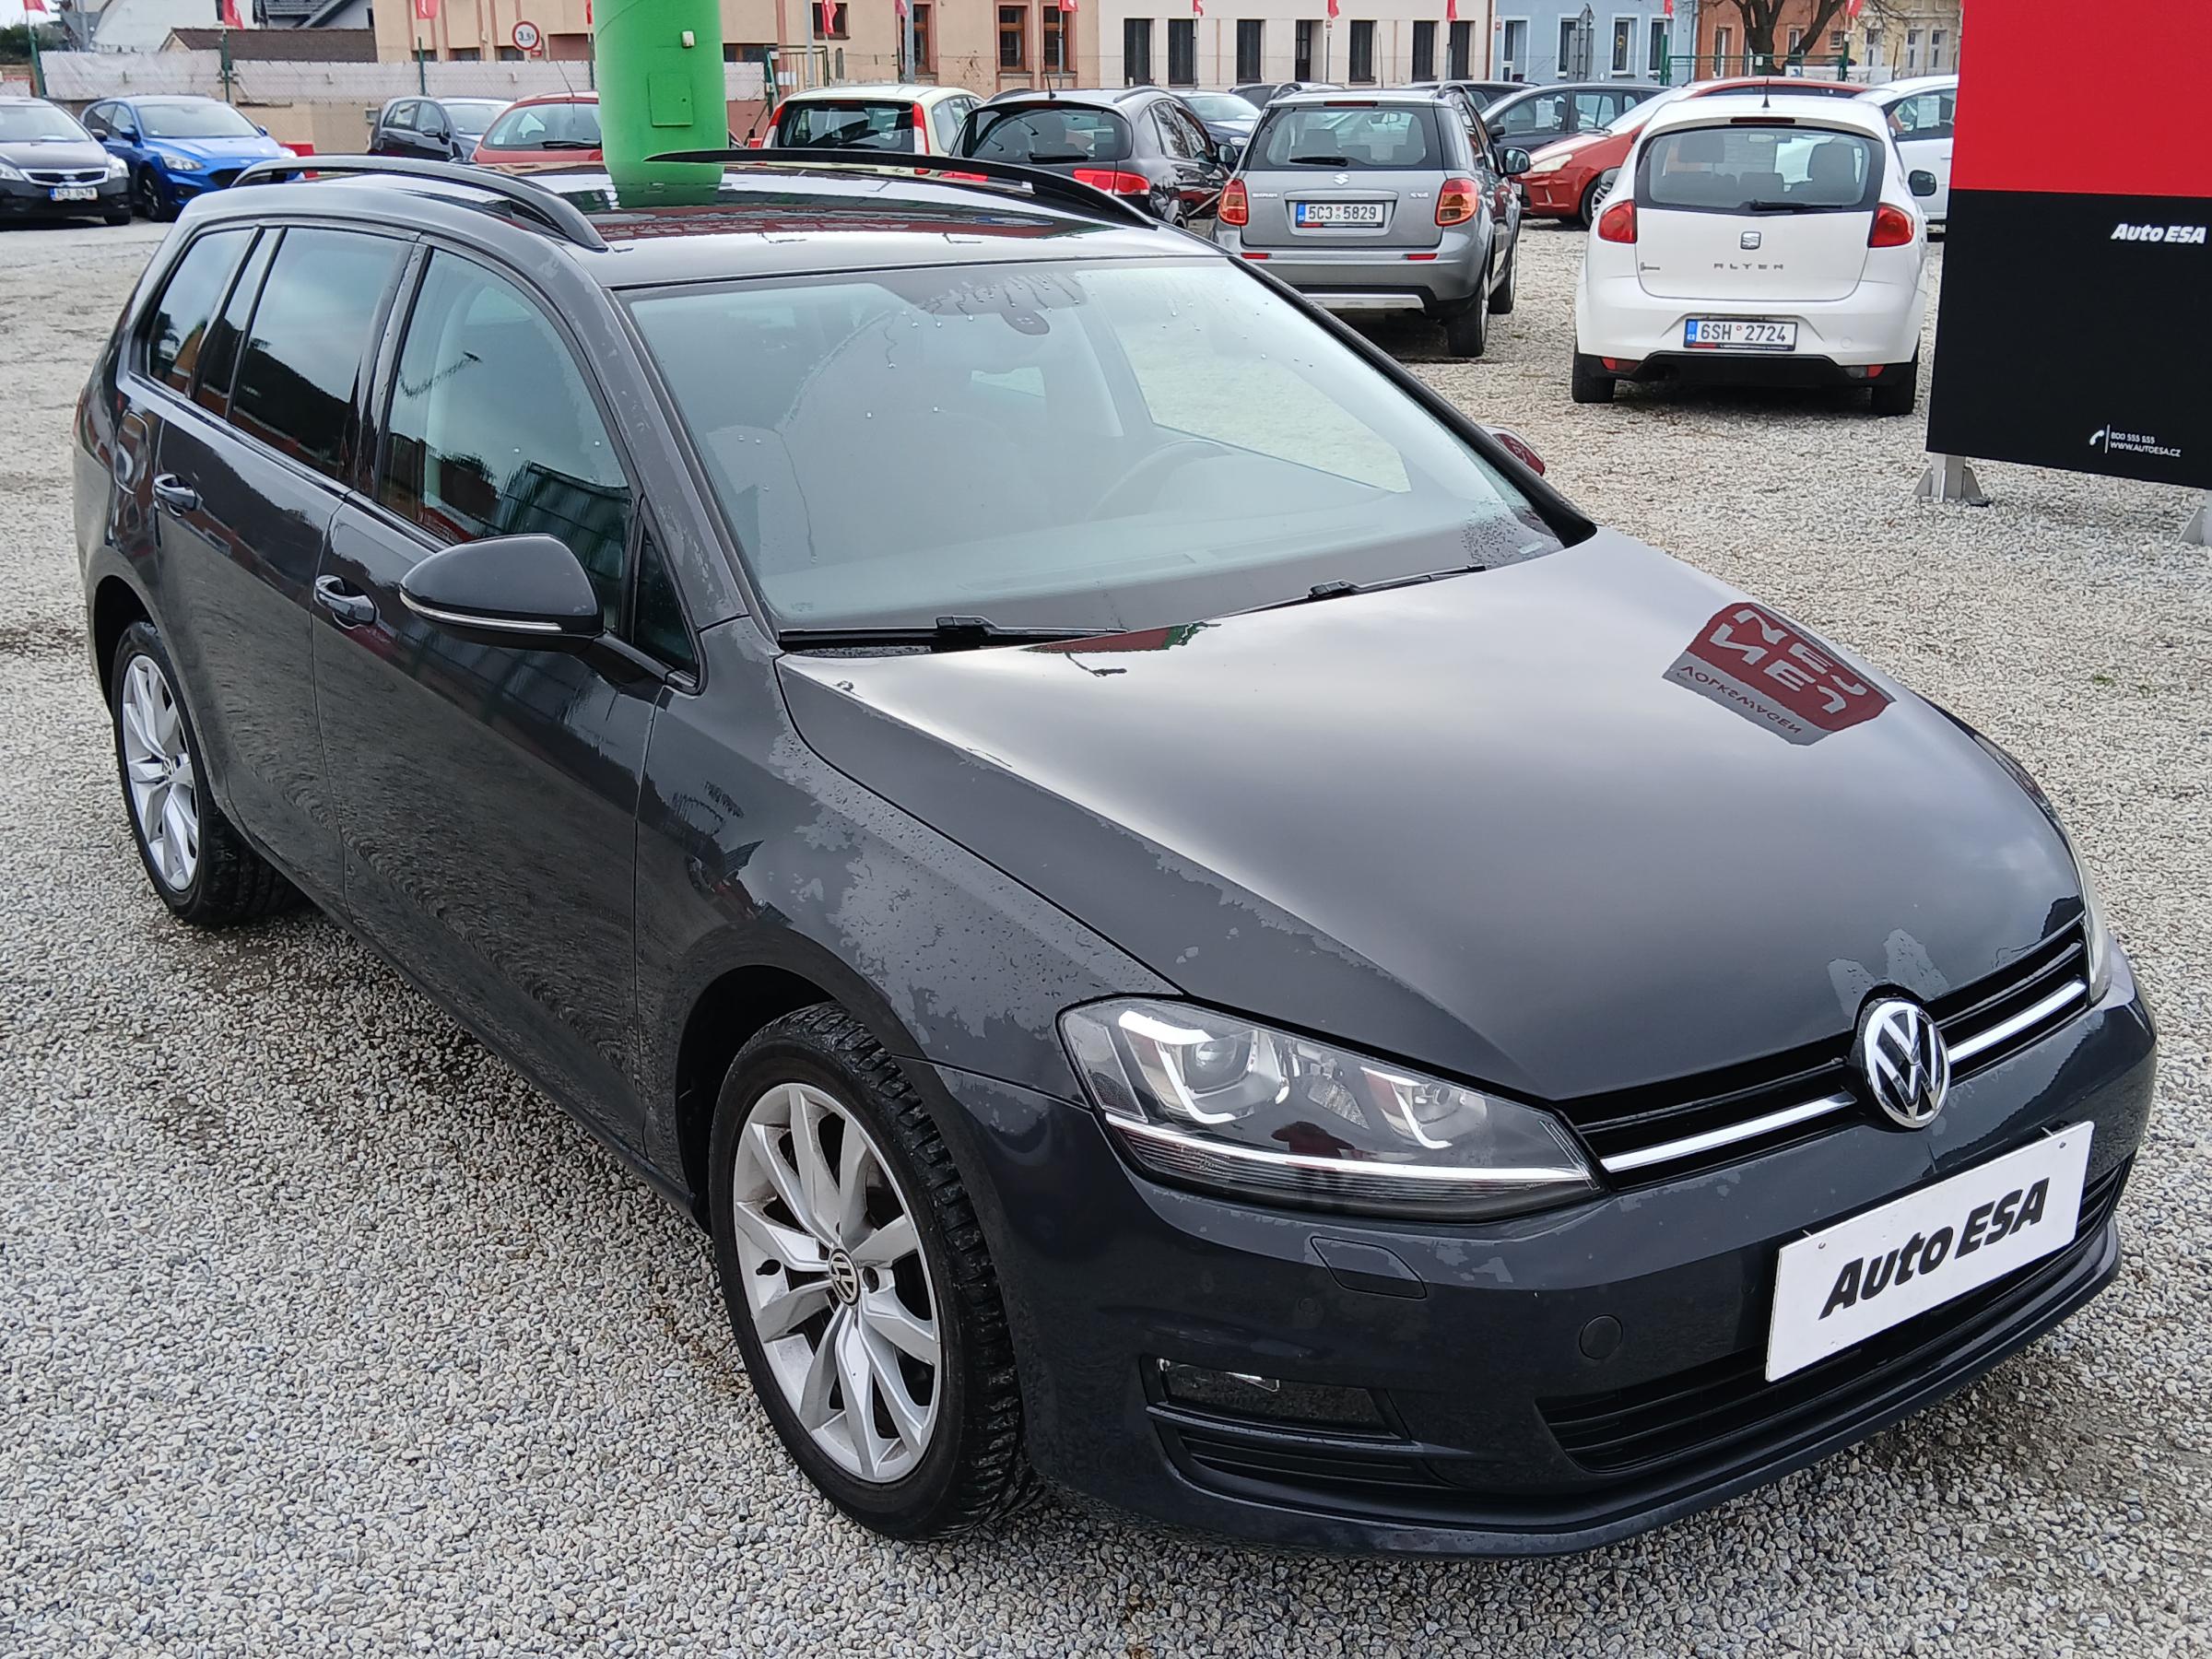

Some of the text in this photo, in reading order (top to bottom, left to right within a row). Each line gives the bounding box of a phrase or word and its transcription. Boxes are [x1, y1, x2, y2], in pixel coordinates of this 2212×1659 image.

[1309, 206, 1377, 219] 5C3 5829
[2110, 223, 2206, 244] Auto ESA
[1700, 324, 1786, 342] 6SH 2724
[1818, 1176, 2050, 1321] Auto ESA
